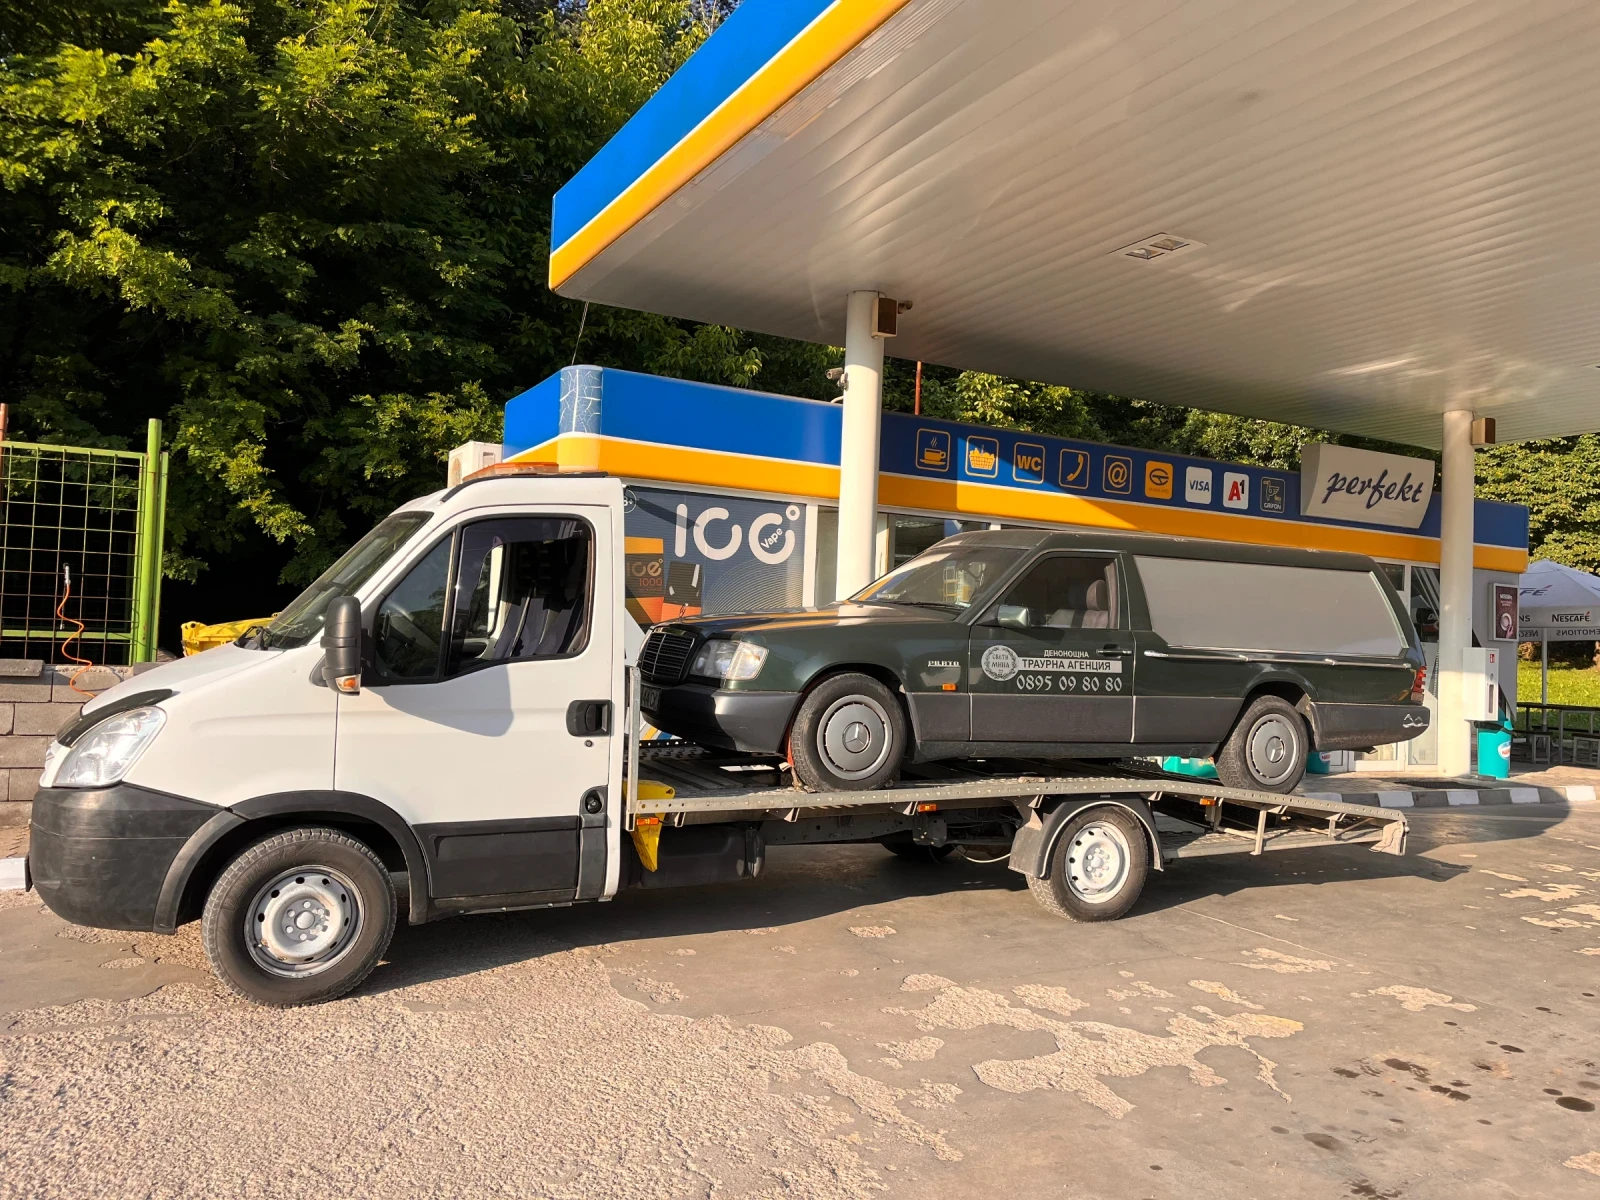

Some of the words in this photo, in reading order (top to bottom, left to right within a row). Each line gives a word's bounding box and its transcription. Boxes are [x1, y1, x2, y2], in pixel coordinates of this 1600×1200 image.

[1017, 454, 1042, 471] WC
[1189, 479, 1210, 492] VISA
[1227, 479, 1246, 501] A1
[1321, 469, 1424, 509] perfekt
[1263, 502, 1282, 510] GRIFON
[760, 527, 783, 549] Vape
[639, 577, 663, 587] 1000
[1043, 649, 1090, 659] ДЕНОНОЩНА
[1021, 658, 1065, 670] ТРАУРНА
[1067, 660, 1112, 673] АГЕНЦИЯ
[1016, 674, 1053, 691] 0895
[1058, 675, 1077, 692] 09
[1082, 677, 1100, 692] 80
[1104, 677, 1123, 692] 80
